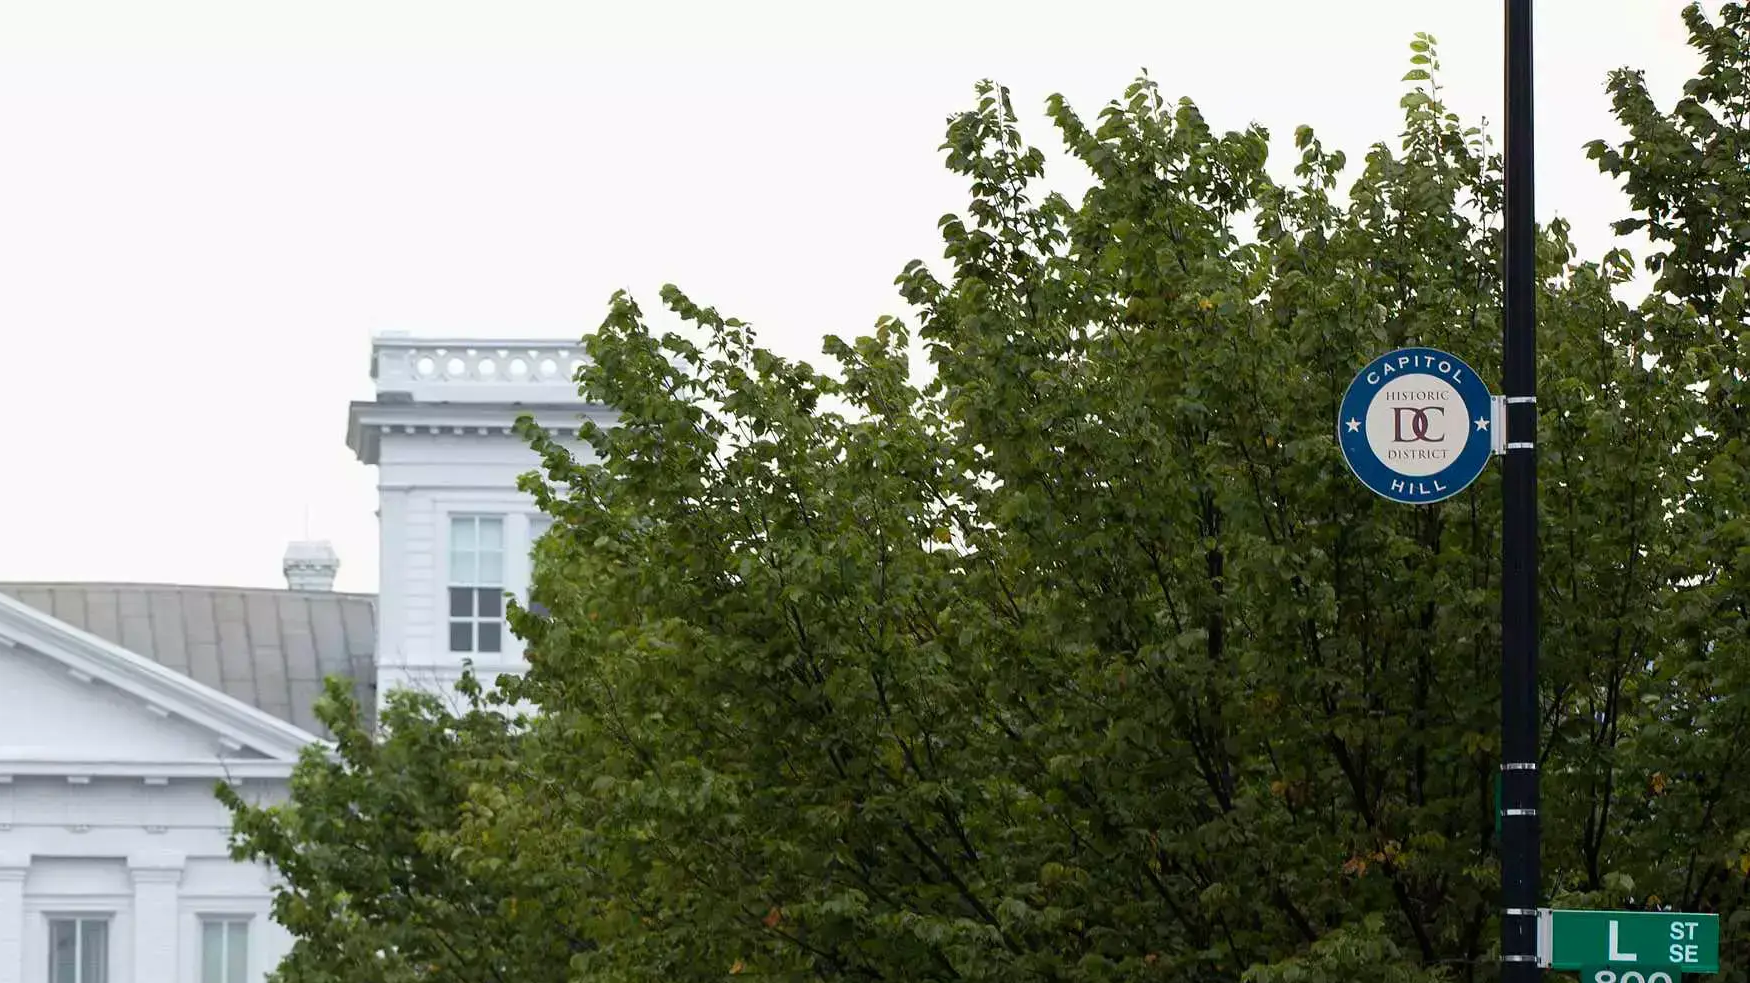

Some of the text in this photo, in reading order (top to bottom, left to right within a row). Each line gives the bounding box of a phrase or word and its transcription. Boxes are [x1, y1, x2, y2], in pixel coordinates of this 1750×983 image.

[1367, 355, 1462, 385] CAPITOL
[1386, 391, 1450, 401] HISTORIC
[1390, 406, 1445, 443] DC
[1388, 449, 1449, 460] DISTRICT
[1391, 479, 1446, 495] HILL
[1609, 920, 1699, 962] L ST
[1669, 944, 1699, 963] SE
